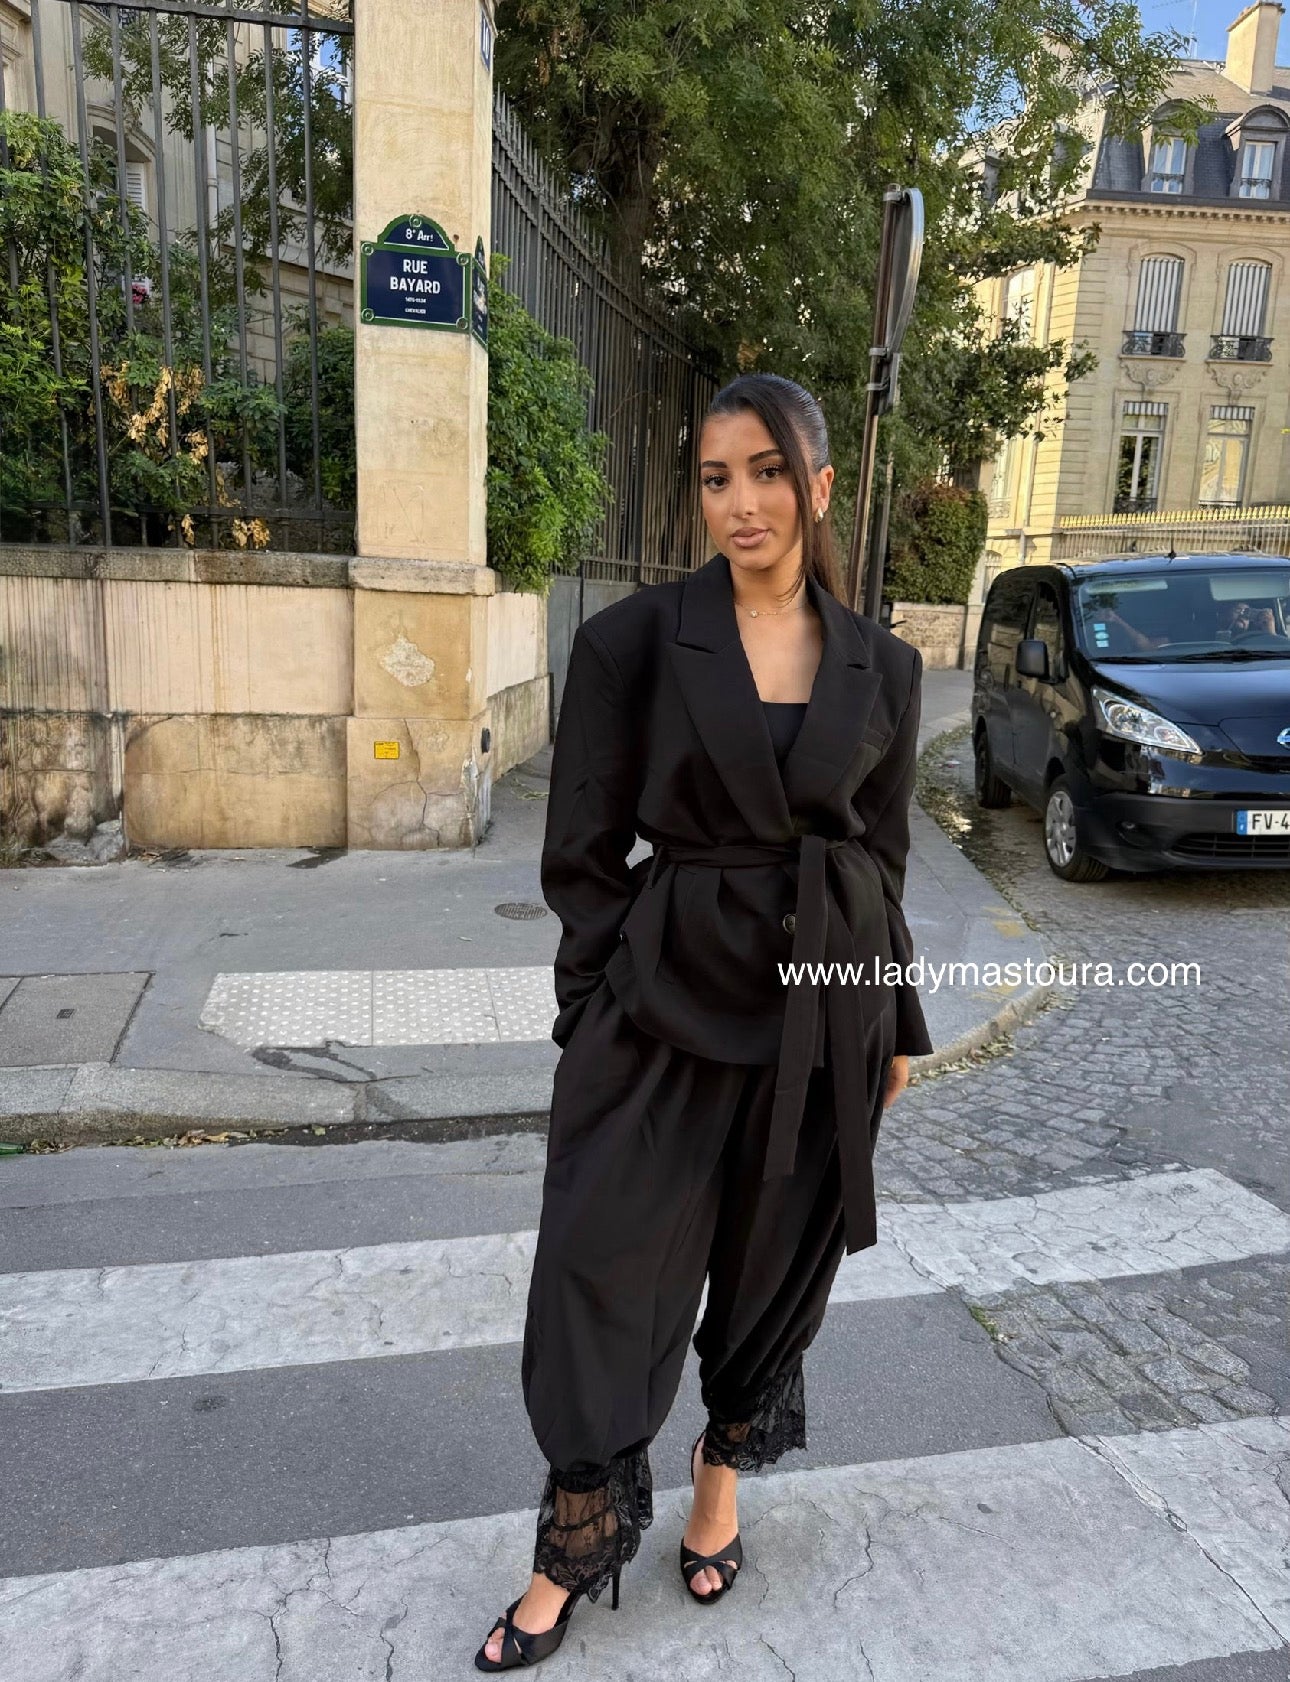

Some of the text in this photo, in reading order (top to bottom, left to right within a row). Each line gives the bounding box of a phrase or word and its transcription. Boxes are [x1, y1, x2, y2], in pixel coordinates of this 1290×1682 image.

[402, 259, 428, 275] RUE
[389, 276, 441, 294] BAYARD
[1252, 813, 1290, 830] FV-4
